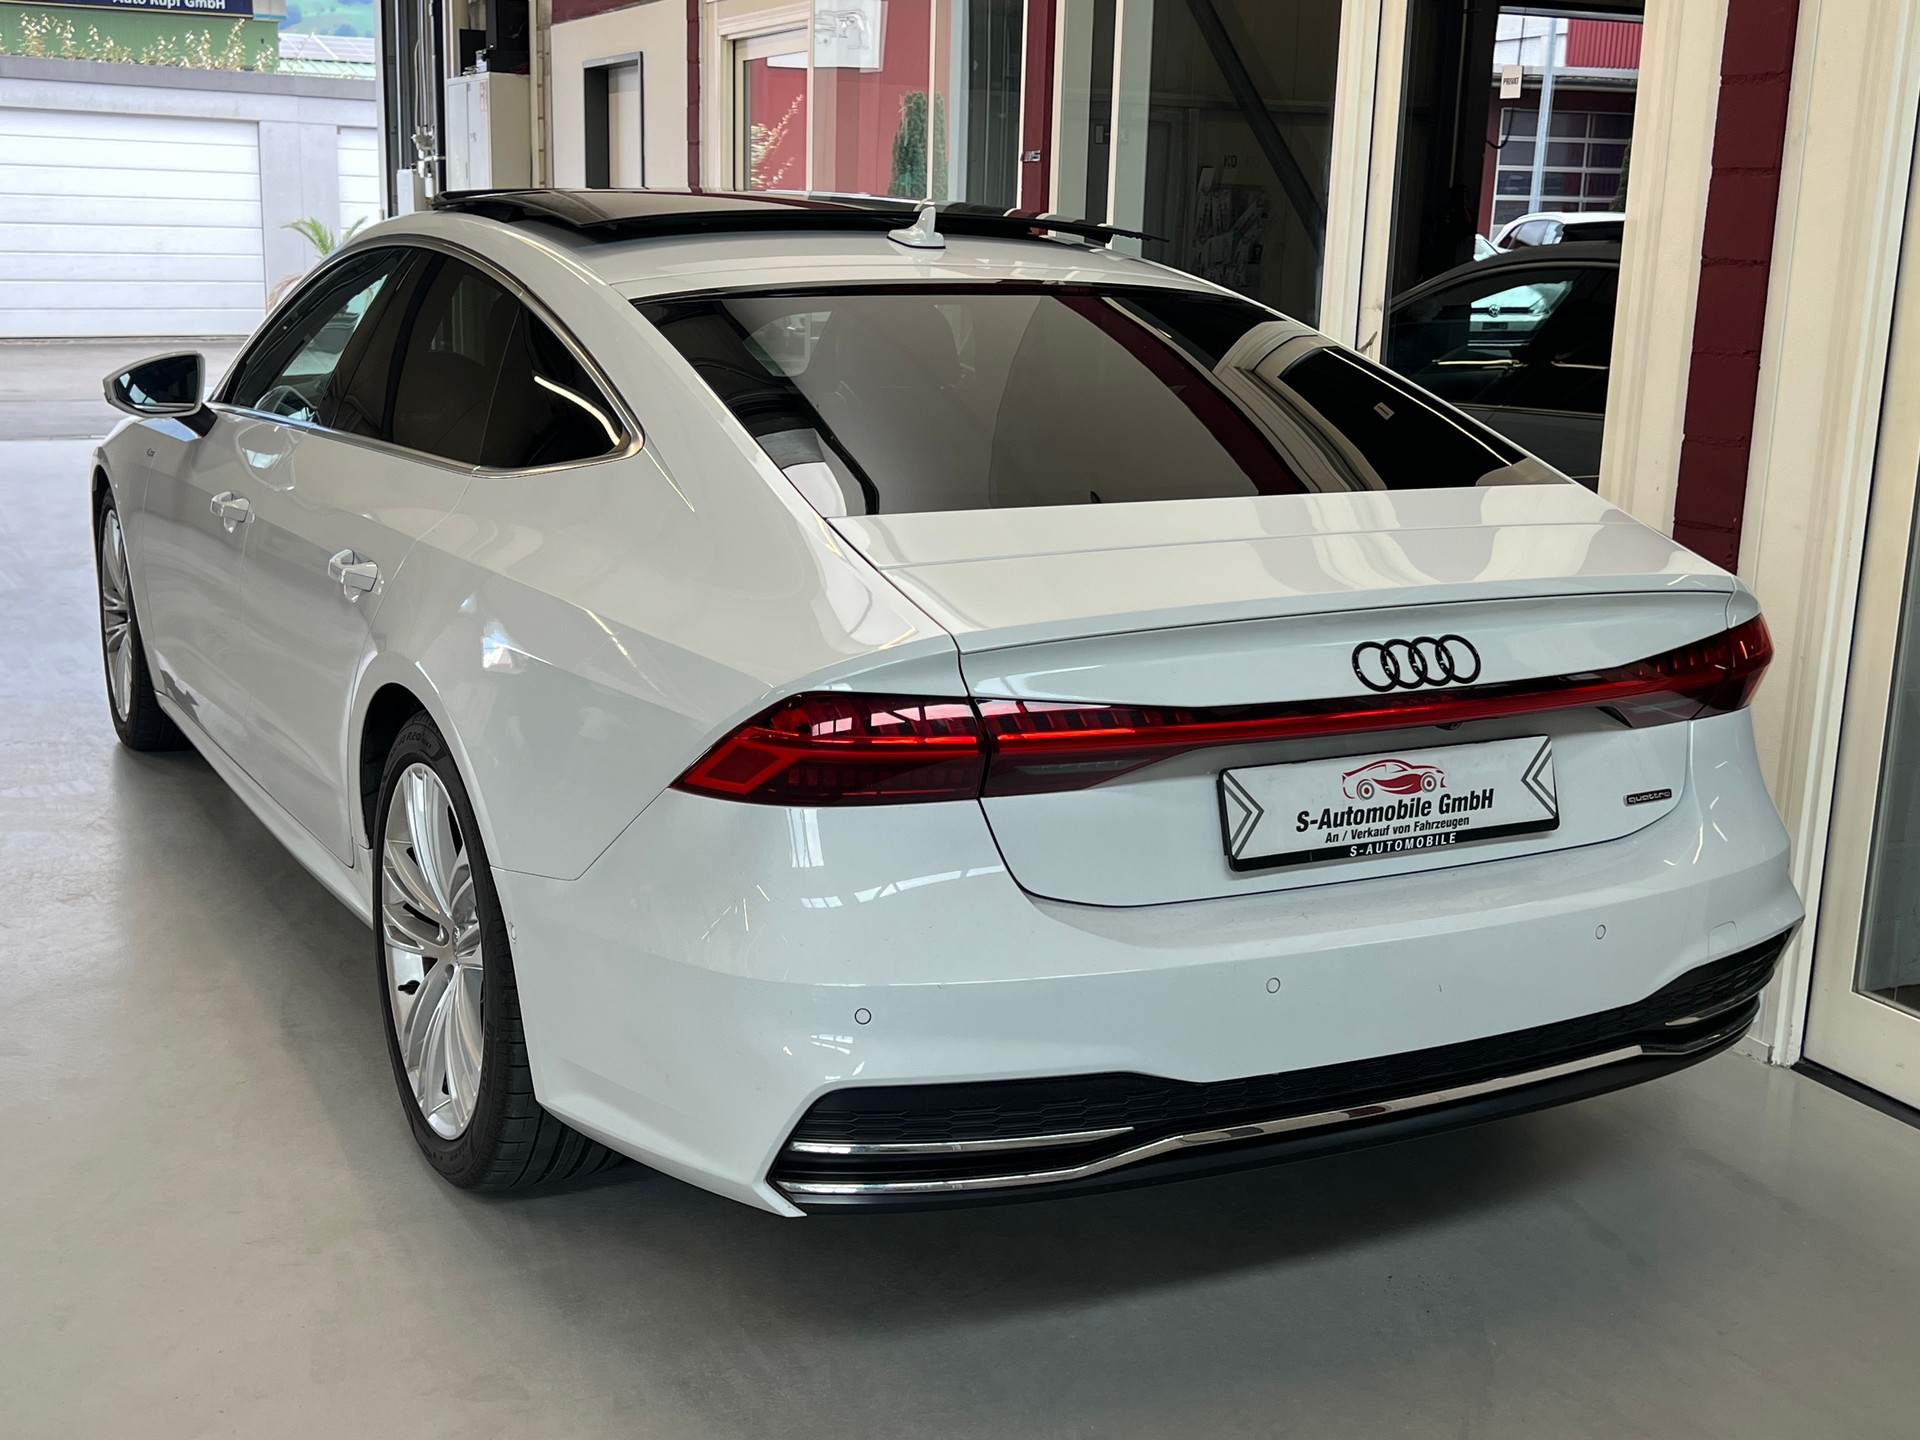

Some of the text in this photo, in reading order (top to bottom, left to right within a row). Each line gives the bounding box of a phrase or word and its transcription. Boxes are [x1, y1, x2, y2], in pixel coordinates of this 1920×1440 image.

[184, 0, 226, 10] GmbH
[1627, 791, 1671, 804] quattro
[1295, 788, 1494, 833] S-Automobile GmbH
[1325, 832, 1339, 844] An
[1351, 824, 1391, 841] Verkauf
[1392, 824, 1411, 836] von
[1413, 816, 1470, 833] Fahrzeugen
[1349, 833, 1456, 857] S-AUTOMOBILE
